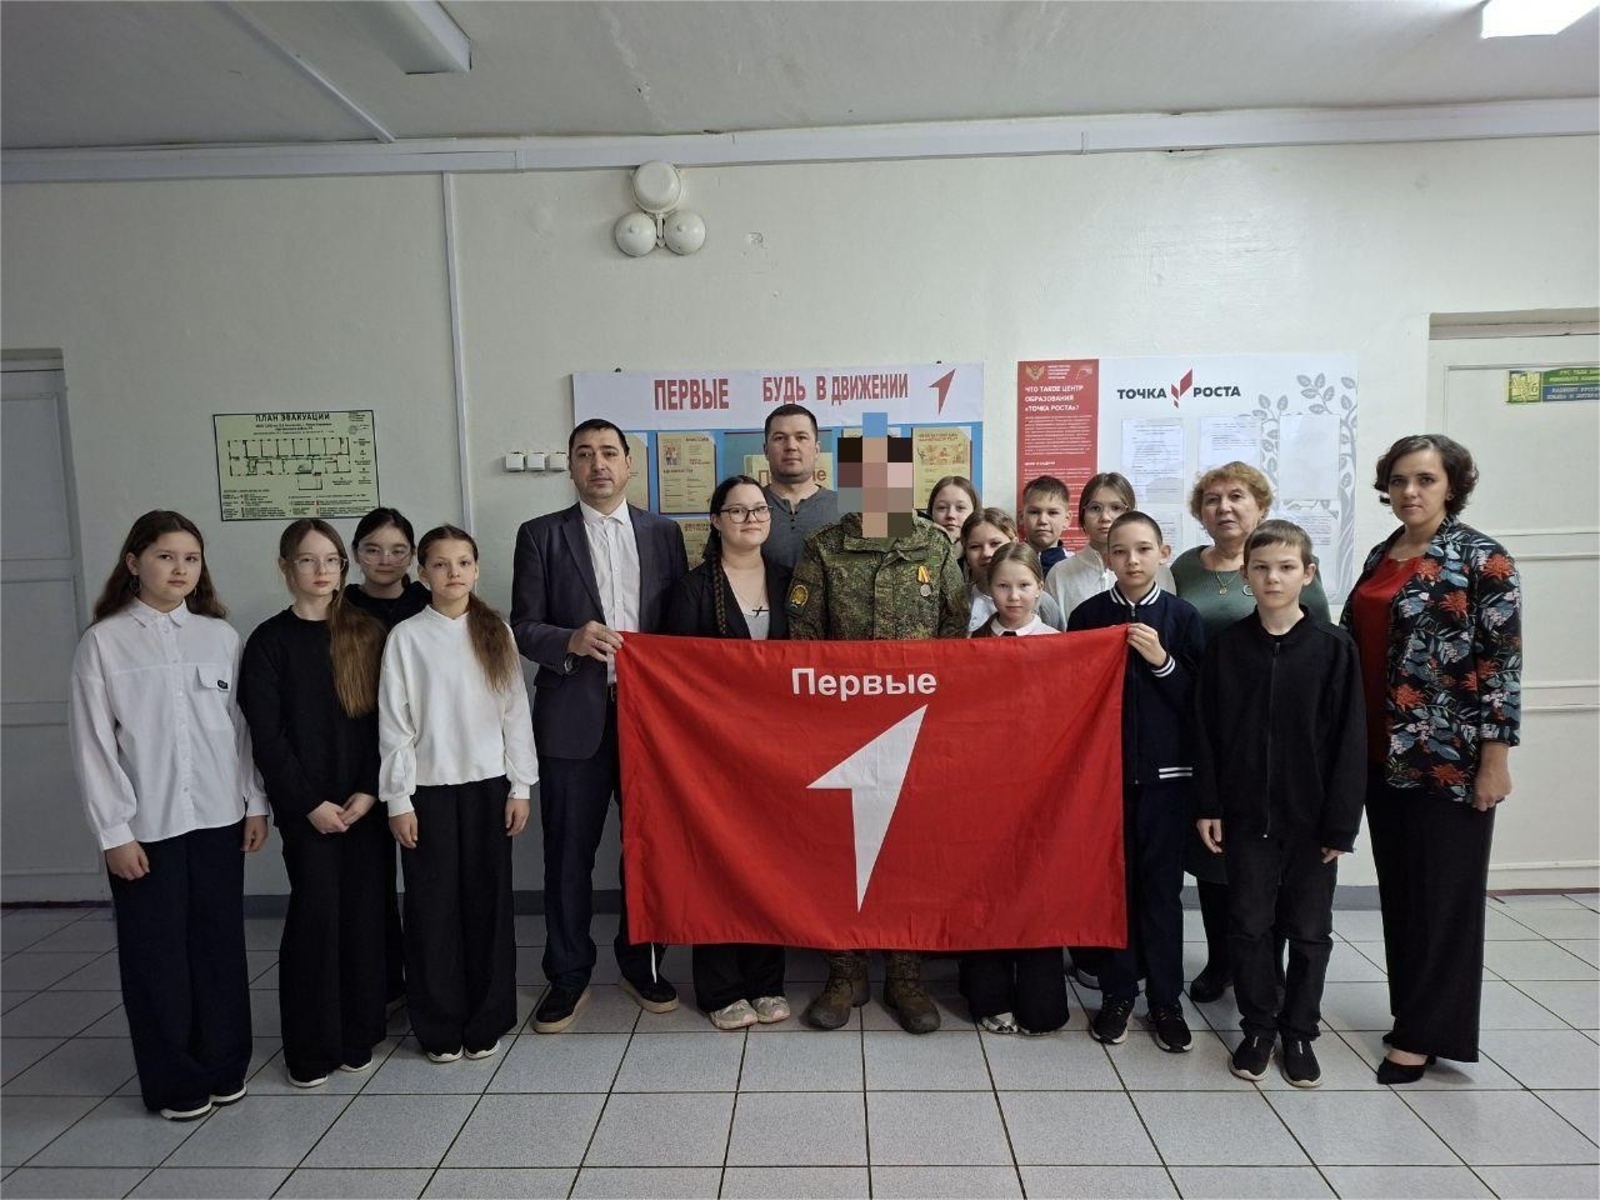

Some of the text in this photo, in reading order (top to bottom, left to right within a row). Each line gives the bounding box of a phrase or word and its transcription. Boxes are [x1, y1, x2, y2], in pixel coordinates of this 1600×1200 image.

[654, 373, 909, 411] ПЕРВЫЕ БУДЬ В ДВИЖЕНИИ
[1062, 384, 1084, 392] ЦЕНТР
[1117, 386, 1241, 400] ТОЧКА РОСТА
[256, 412, 331, 422] ПЛАН ЭВАКУАЦИИ
[791, 667, 938, 702] Первые
